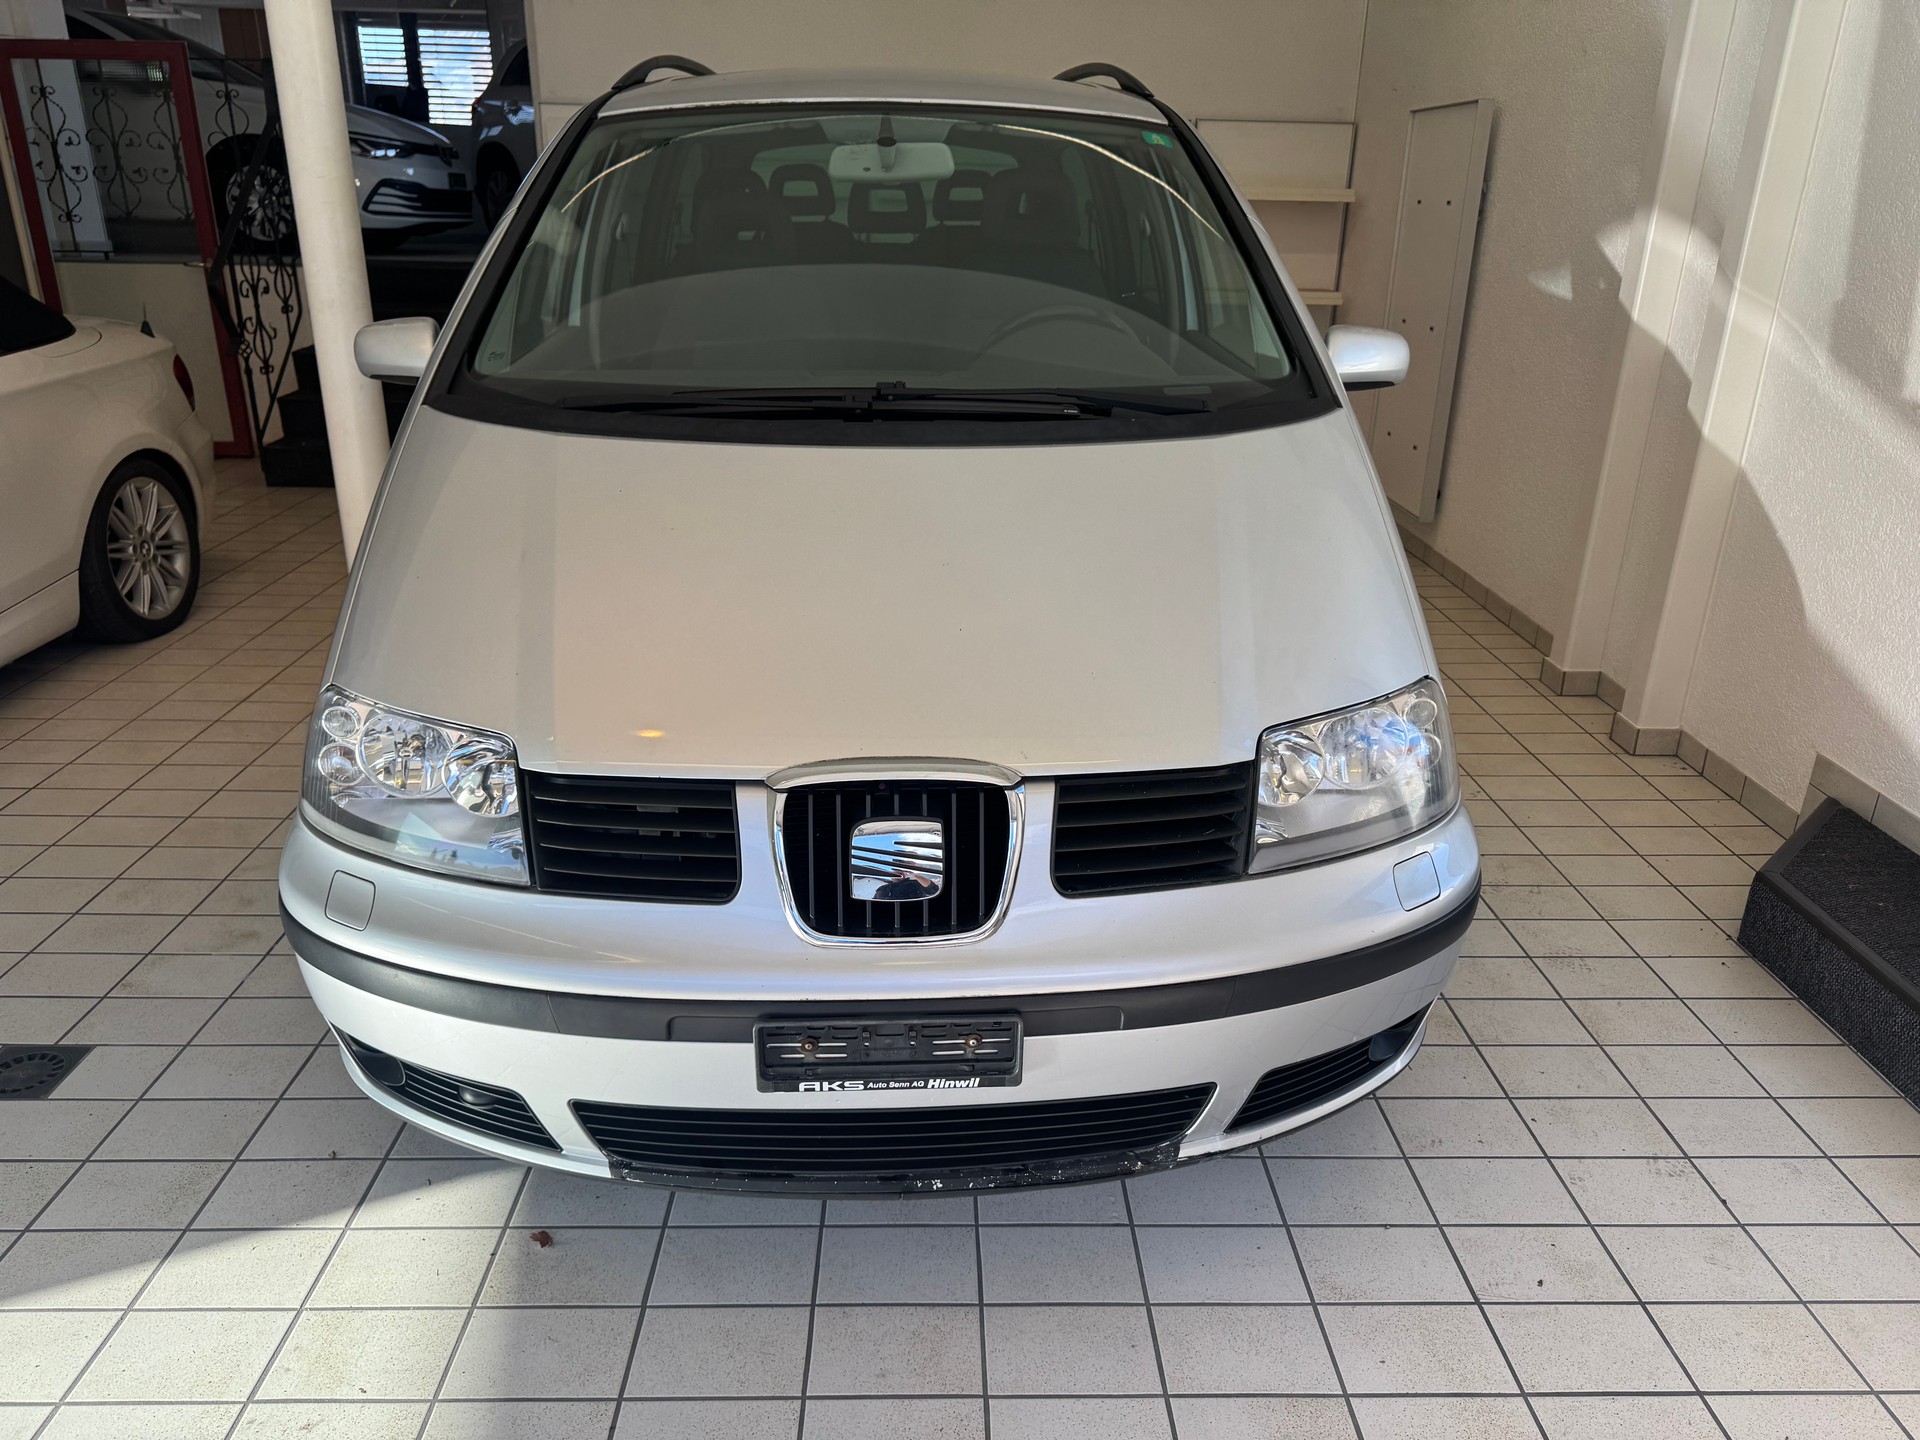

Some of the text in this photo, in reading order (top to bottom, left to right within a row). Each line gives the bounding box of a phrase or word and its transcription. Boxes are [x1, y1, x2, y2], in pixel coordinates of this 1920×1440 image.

[799, 1081, 864, 1092] AKS
[911, 1080, 925, 1088] AG
[927, 1077, 981, 1089] Hinwil
